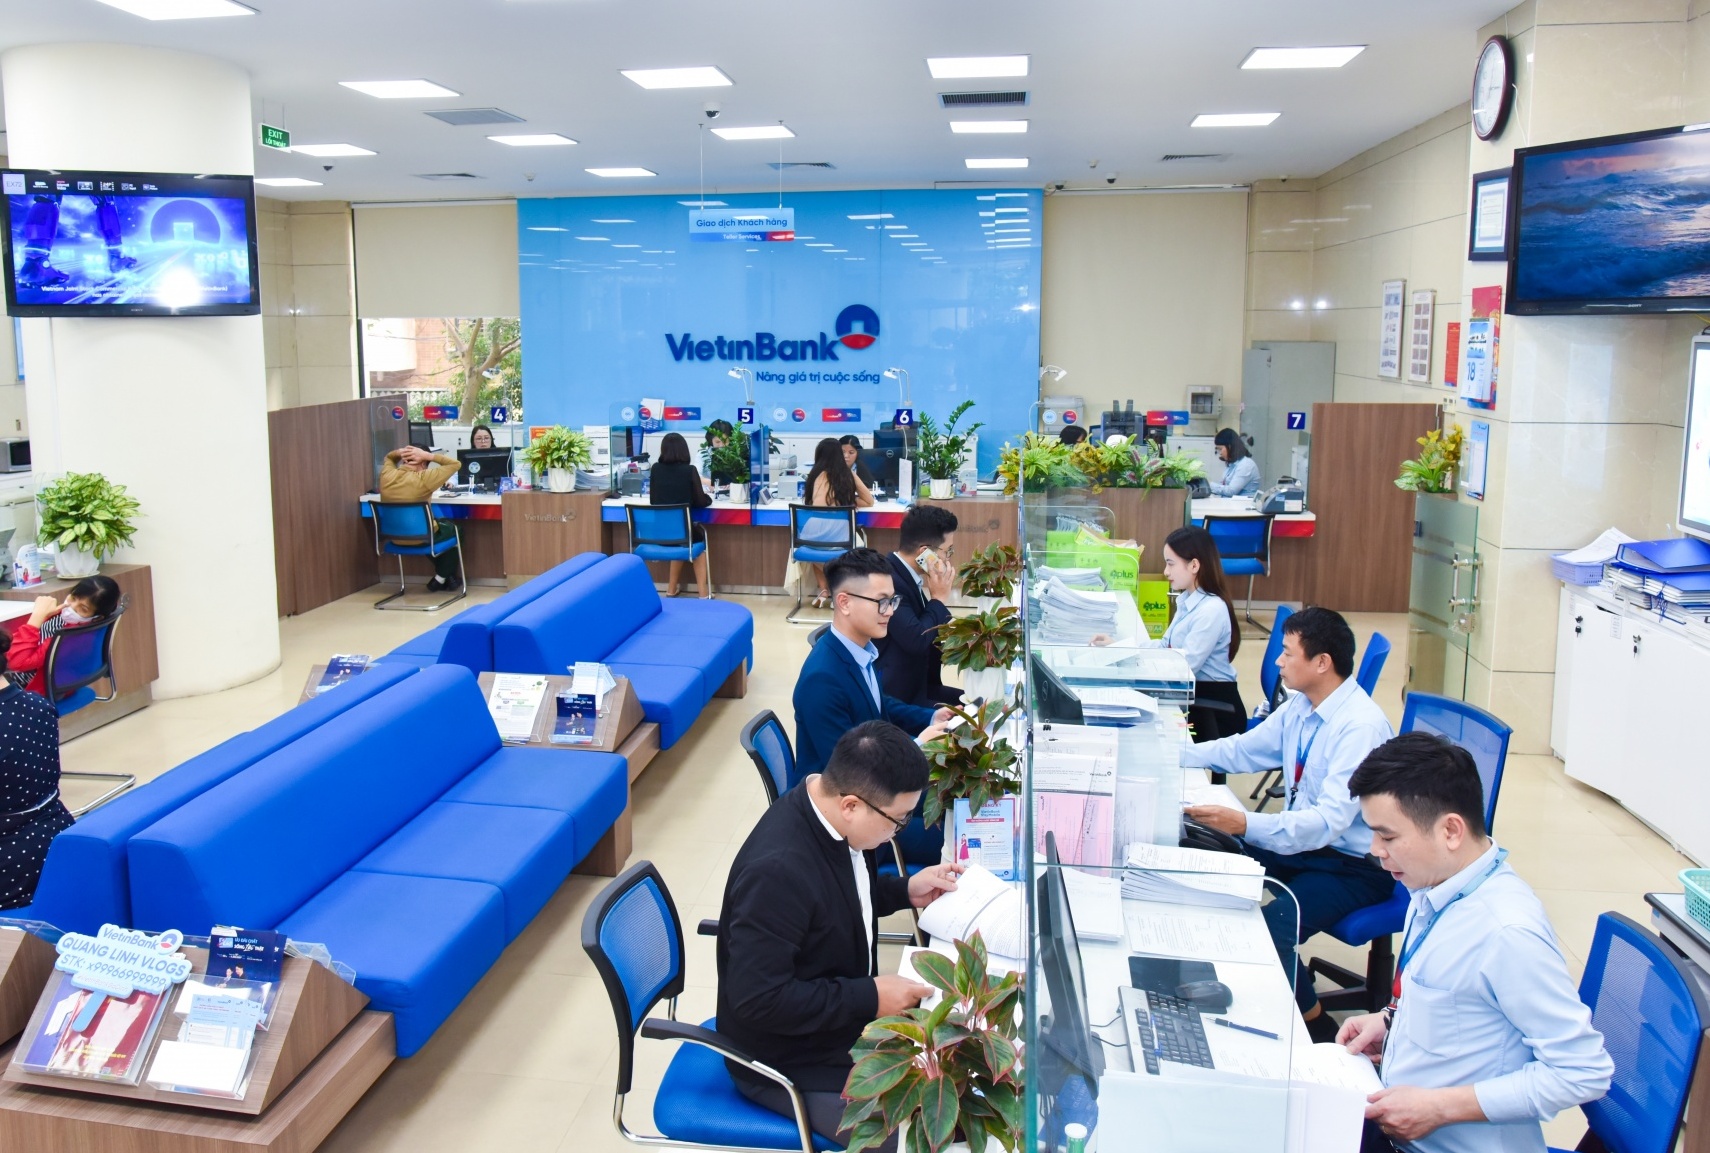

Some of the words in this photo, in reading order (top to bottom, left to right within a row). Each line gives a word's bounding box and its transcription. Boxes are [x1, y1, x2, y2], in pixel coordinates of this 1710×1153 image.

[268, 128, 283, 140] EXIT
[696, 219, 717, 228] Giao
[717, 218, 736, 229] dịch
[737, 218, 764, 227] Khách
[765, 217, 788, 228] hàng
[665, 331, 840, 361] VietinBank
[756, 371, 786, 384] Nâng
[788, 370, 807, 384] giá
[809, 371, 821, 385] trị
[822, 371, 851, 385] cuộc
[852, 369, 881, 385] sống
[1467, 361, 1476, 382] 18
[493, 408, 504, 422] 4
[740, 409, 751, 423] 5
[899, 410, 910, 424] 6
[1291, 413, 1303, 428] 7
[103, 927, 160, 951] VietinBank
[62, 936, 109, 957] QUANG
[108, 947, 141, 966] LINH
[141, 955, 187, 977] VLOGS
